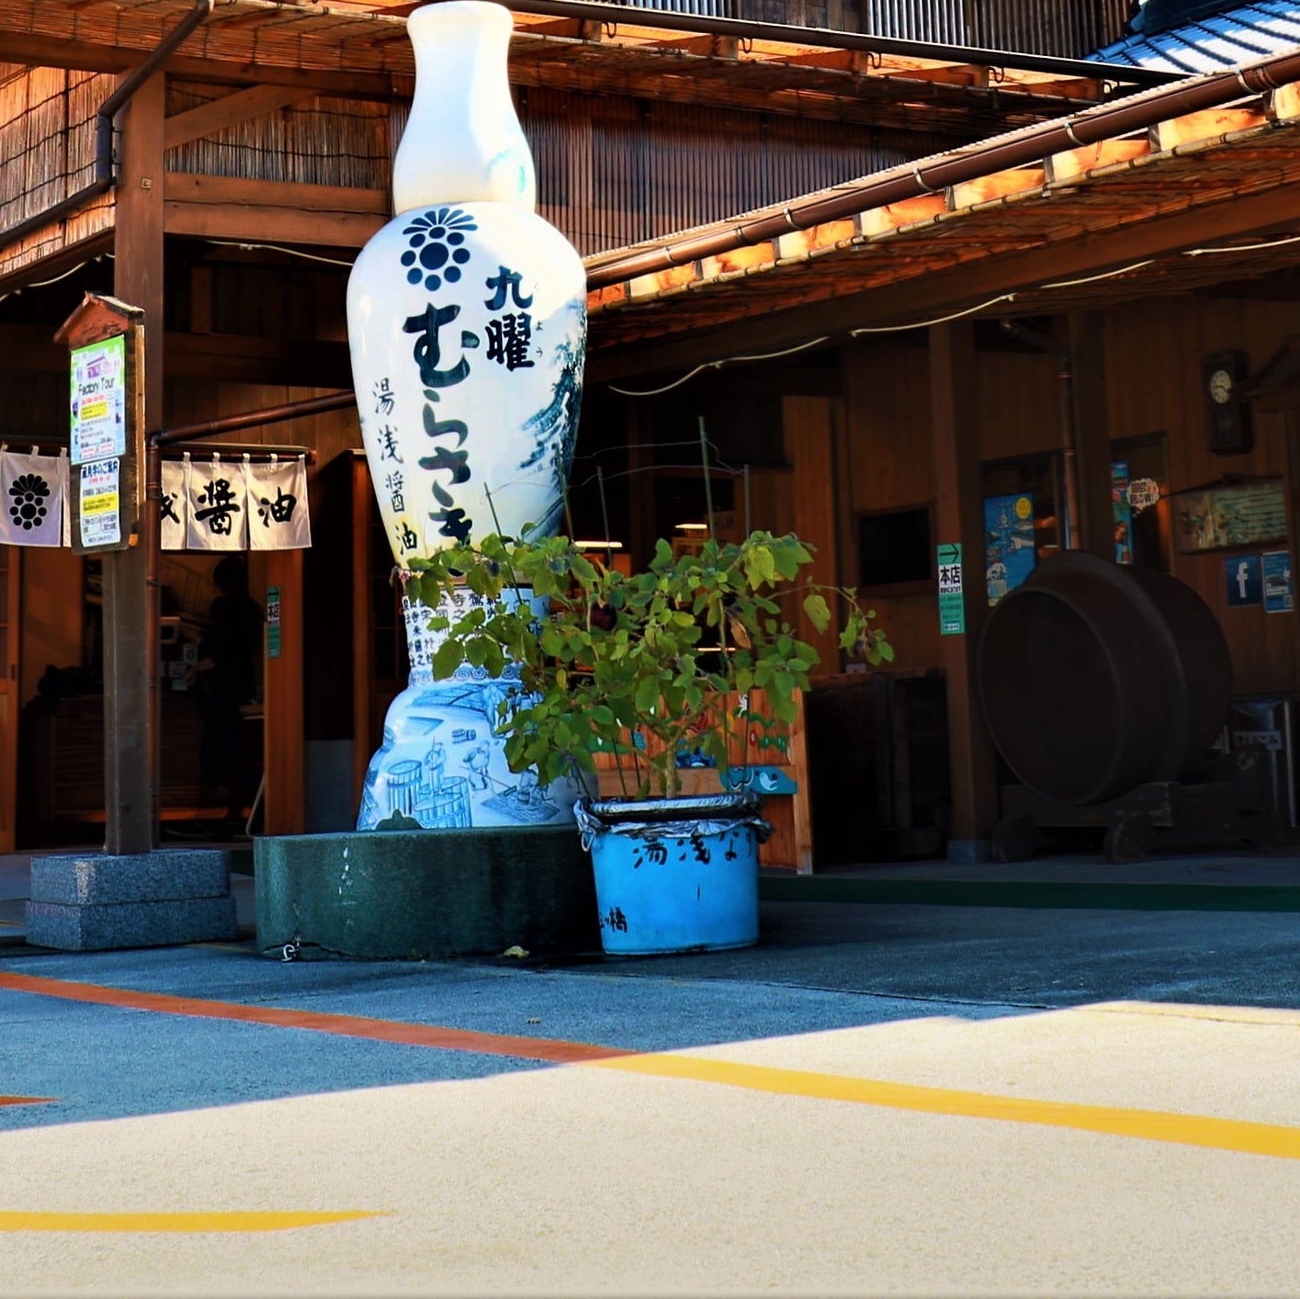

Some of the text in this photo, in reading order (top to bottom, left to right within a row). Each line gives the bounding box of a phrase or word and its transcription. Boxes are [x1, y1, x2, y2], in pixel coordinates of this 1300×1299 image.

[484, 265, 535, 372] 九曜
[79, 376, 115, 396] Factory Tour
[402, 302, 480, 577] むらさき
[373, 377, 418, 556] 湯浅醤油
[940, 565, 961, 585] 本店
